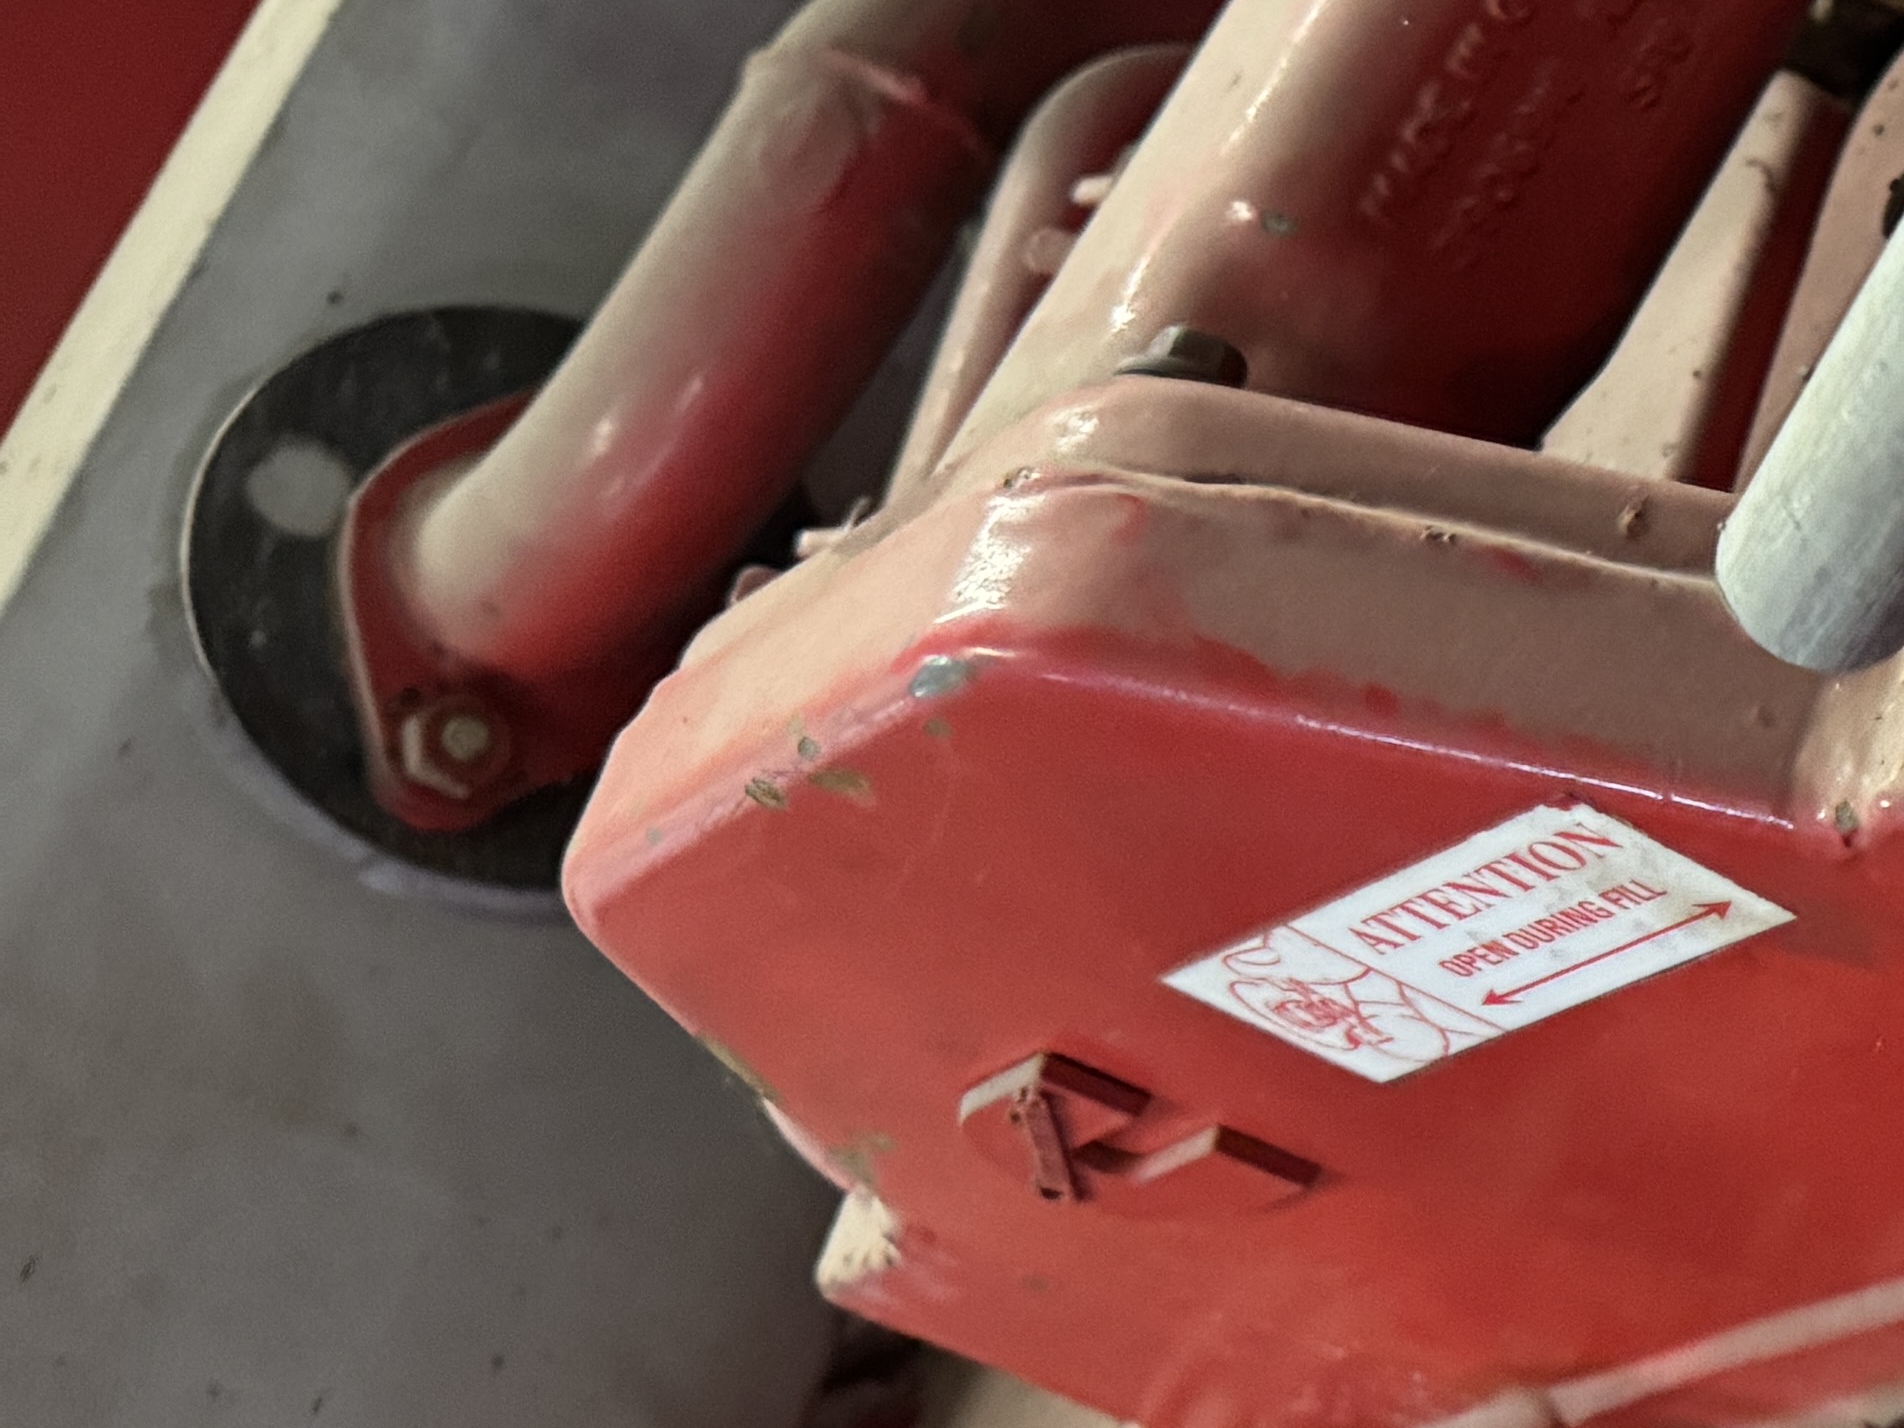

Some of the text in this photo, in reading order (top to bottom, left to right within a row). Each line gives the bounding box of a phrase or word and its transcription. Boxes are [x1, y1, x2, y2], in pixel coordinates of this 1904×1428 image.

[1348, 822, 1623, 955] ATTENTION
[1438, 879, 1668, 977] OPEN DURING FILL
